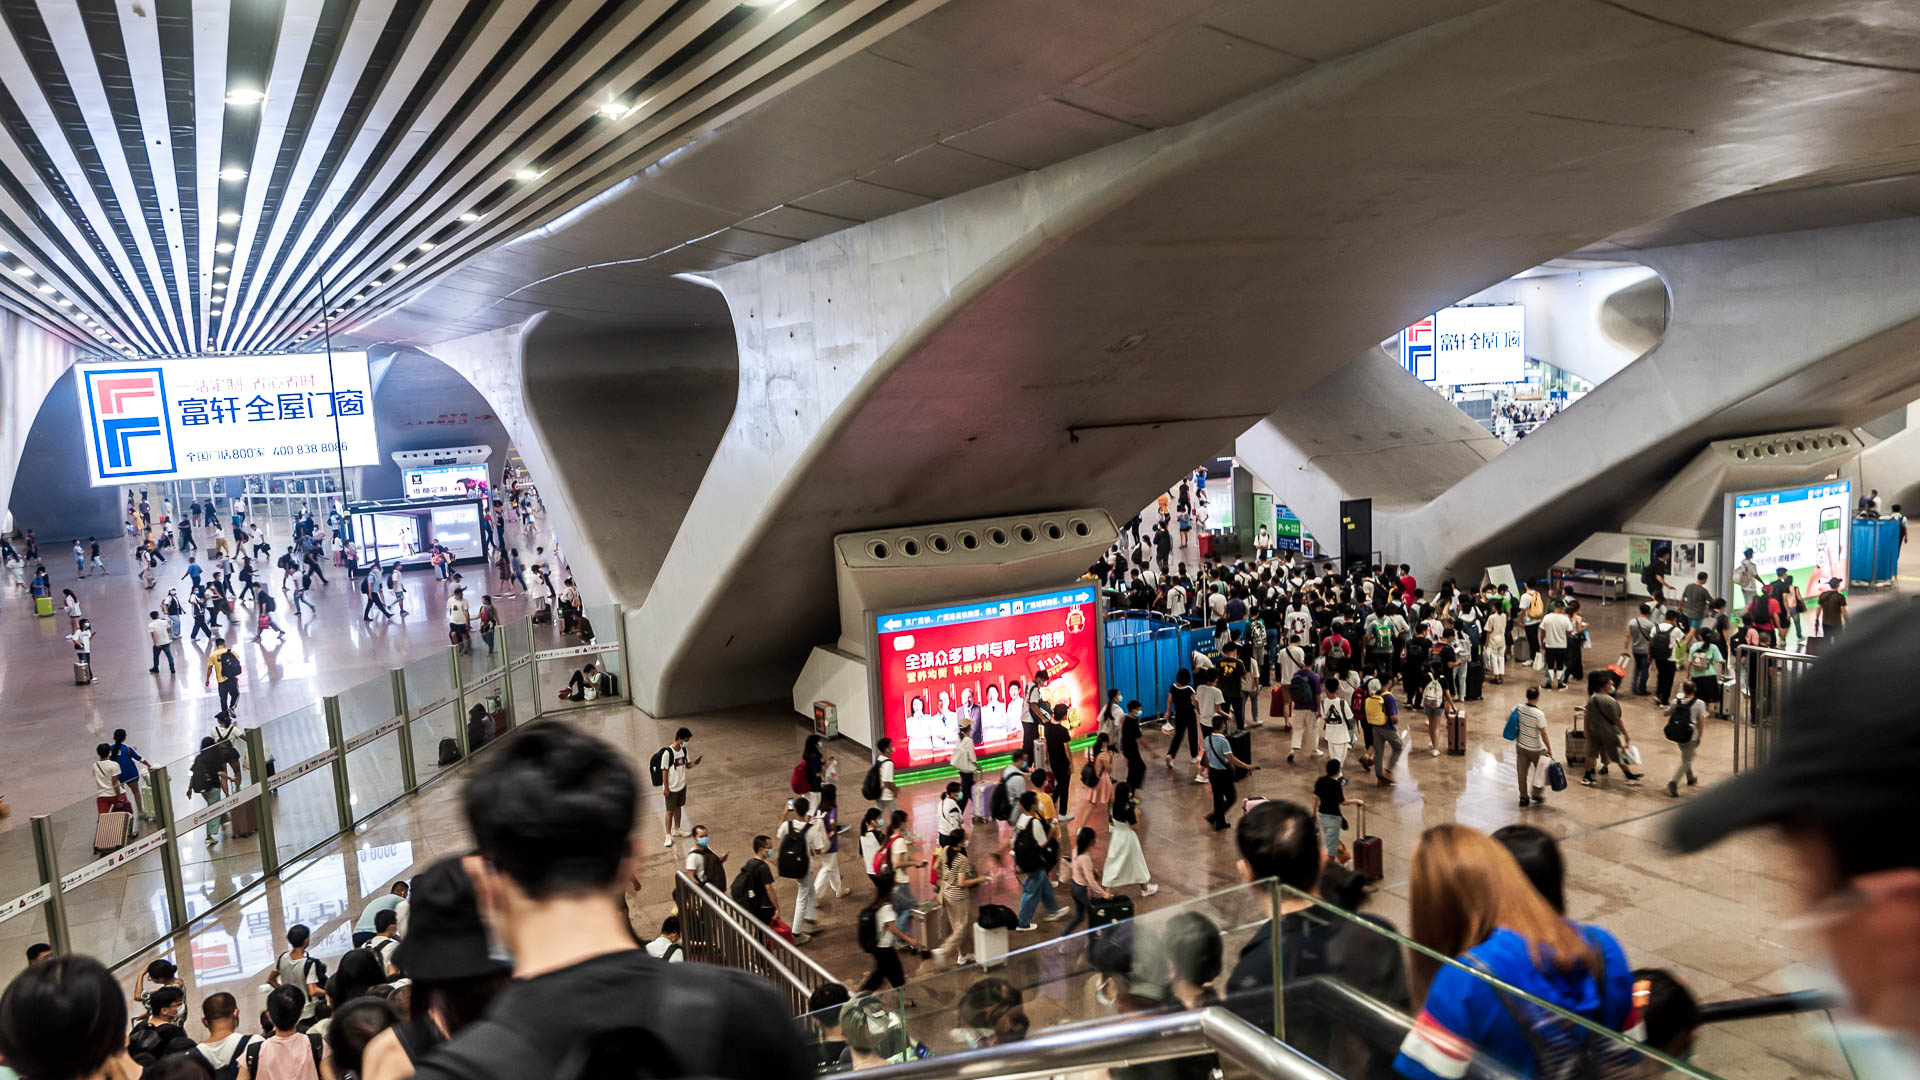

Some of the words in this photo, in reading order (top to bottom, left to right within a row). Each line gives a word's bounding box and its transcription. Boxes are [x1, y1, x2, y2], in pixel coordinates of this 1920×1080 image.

[178, 389, 364, 426] 富轩全屋门窗
[273, 446, 294, 456] 400
[297, 444, 318, 455] 838
[321, 442, 348, 453] 8086
[906, 631, 1065, 671] 全球众多营养专家一致推荐
